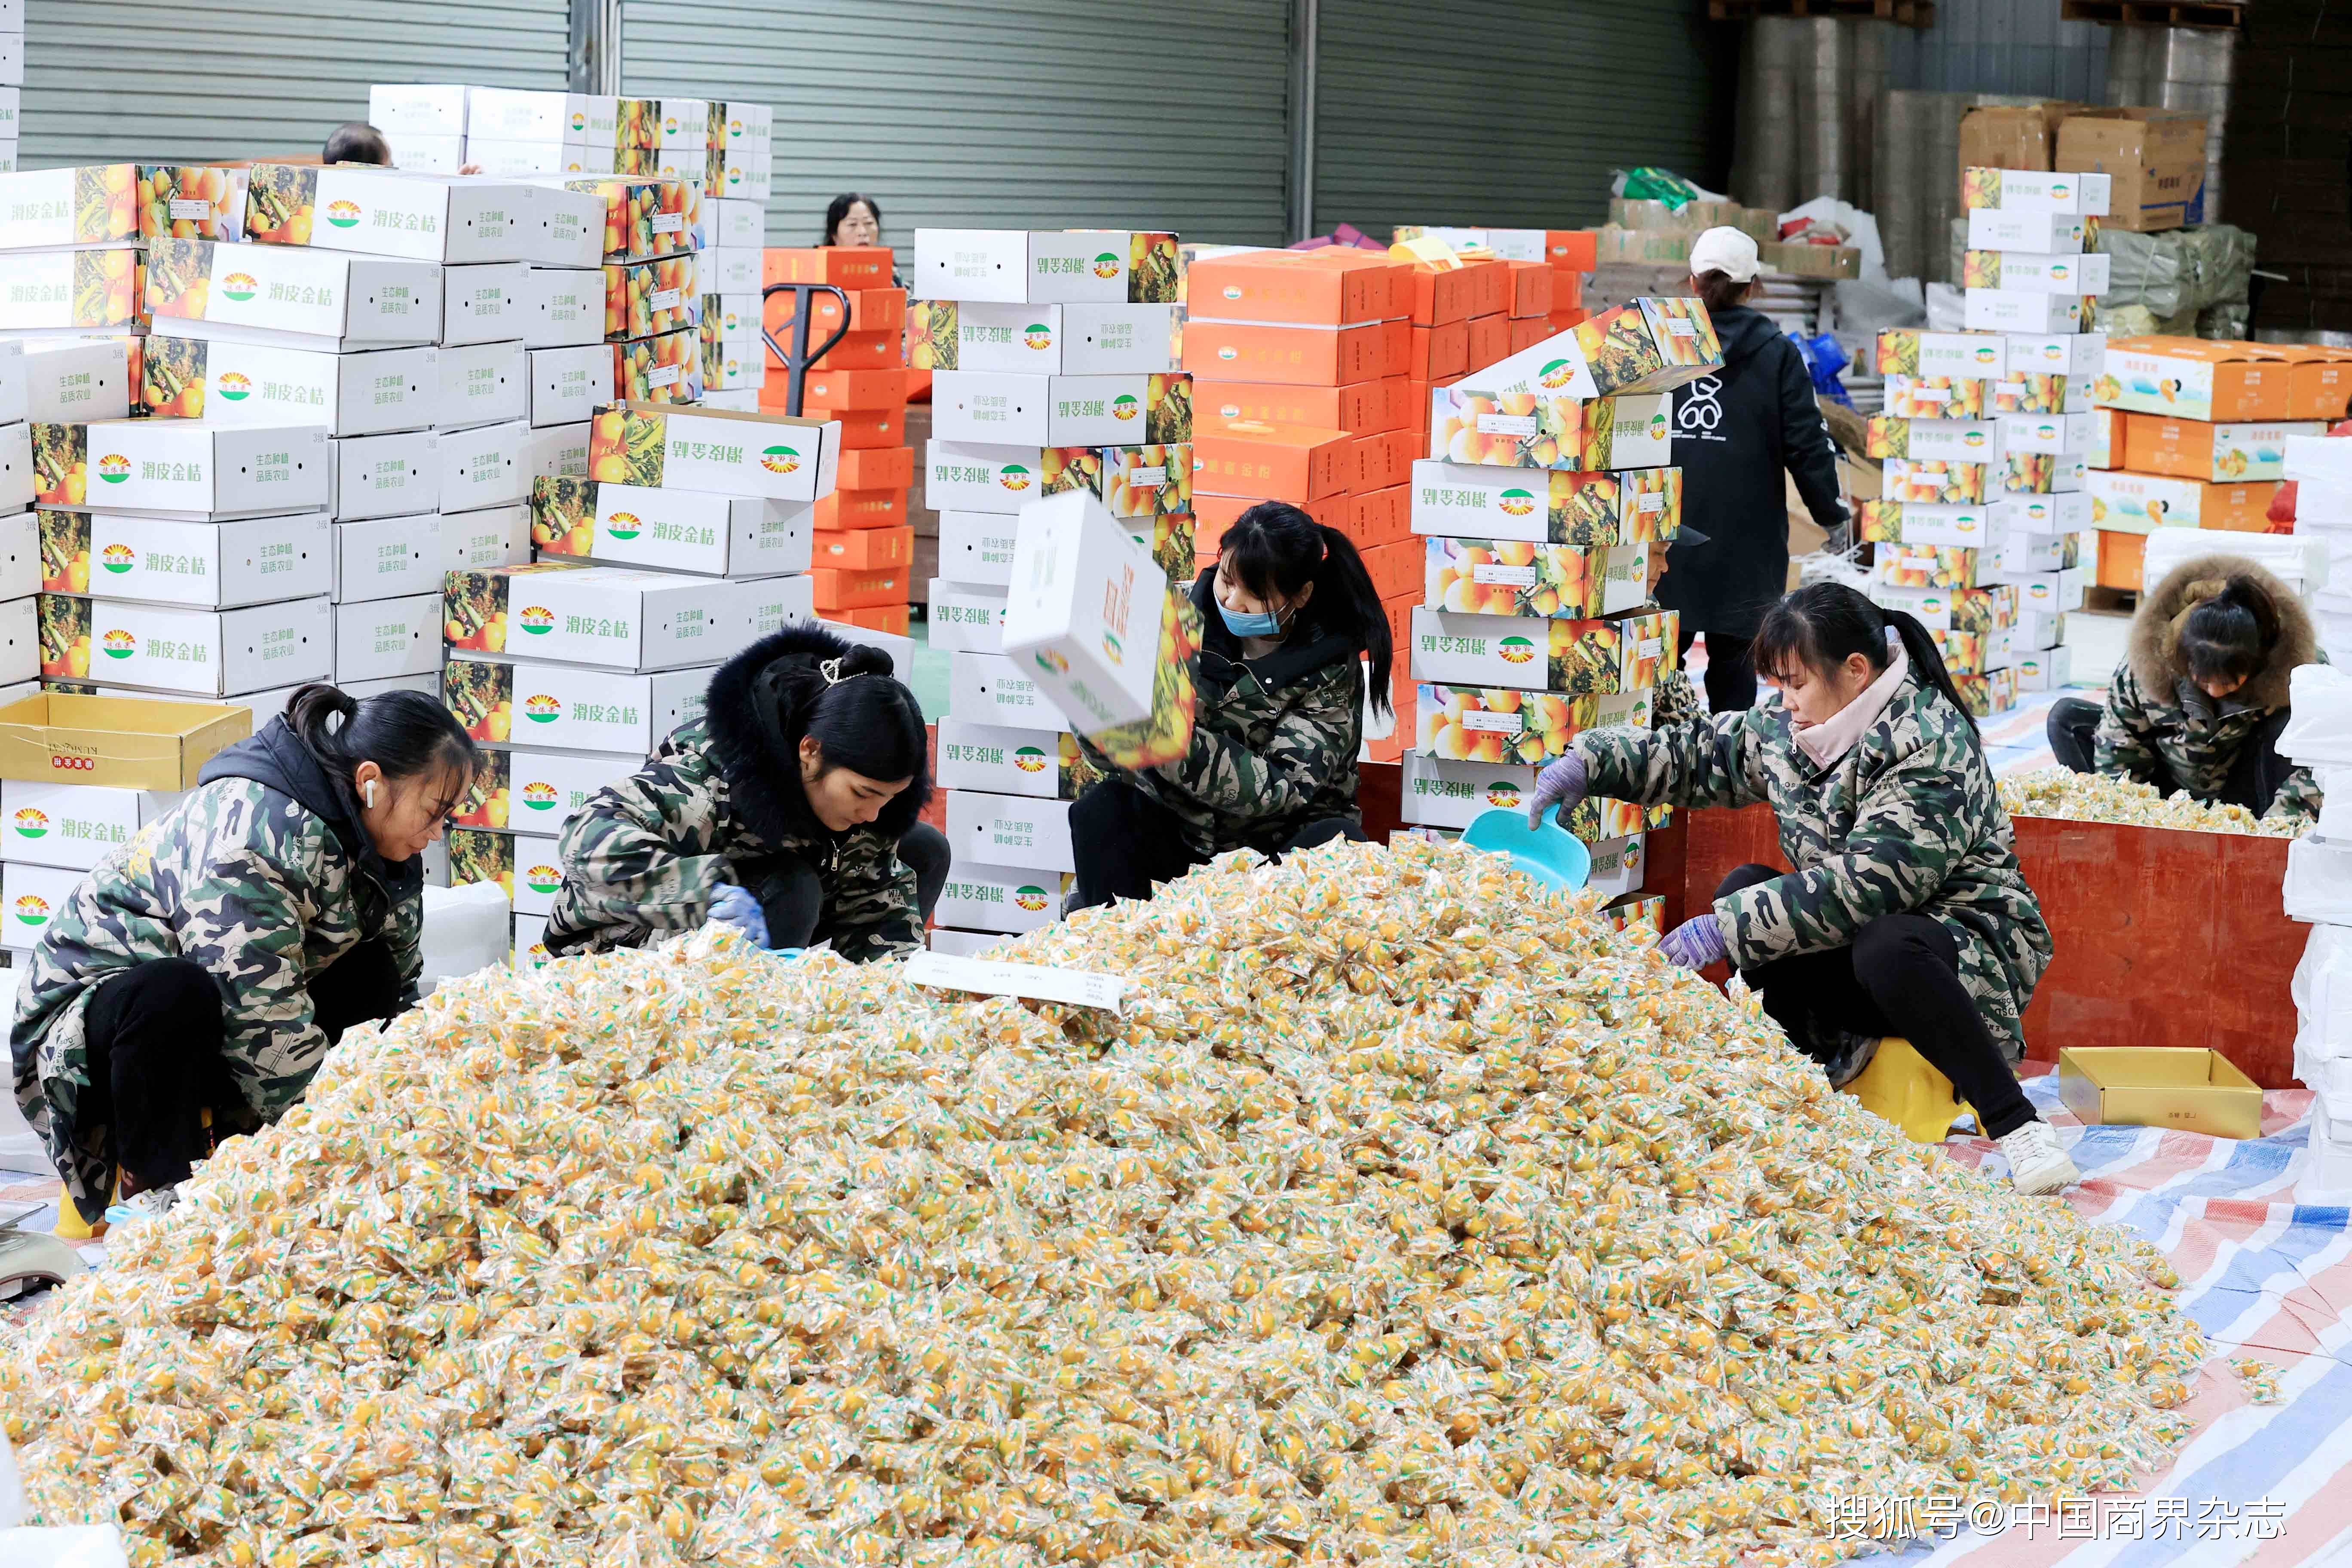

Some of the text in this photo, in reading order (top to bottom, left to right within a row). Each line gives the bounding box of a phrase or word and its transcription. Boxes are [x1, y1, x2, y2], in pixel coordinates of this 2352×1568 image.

[524, 189, 533, 199] 3级
[11, 200, 69, 220] 滑皮金桔
[597, 199, 606, 208] 3级
[372, 208, 437, 233] 滑皮金桔
[479, 210, 504, 223] 生态种植
[554, 213, 578, 226] 生态种植
[478, 227, 503, 238] 品质农业
[553, 227, 577, 241] 品质农业
[954, 251, 987, 264] 品质农业
[954, 266, 987, 278] 生态种植
[1037, 257, 1085, 274] 滑皮金桔
[430, 269, 440, 279] 3级
[520, 269, 529, 278] 3级
[594, 276, 604, 286] 3级
[10, 283, 69, 303] 滑皮金桔
[268, 282, 333, 306] 滑皮金桔
[381, 285, 409, 298] 生态种植
[475, 288, 501, 300] 生态种植
[551, 295, 576, 306] 生态种植
[380, 302, 408, 315] 品质农业
[474, 302, 500, 317] 品质农业
[551, 309, 576, 320] 品质农业
[963, 325, 1012, 344] 滑皮金桔
[1100, 323, 1133, 334] 品质农业
[10, 345, 22, 356] 3级
[513, 343, 523, 354] 3级
[1100, 338, 1132, 349] 生态种植
[113, 348, 124, 359] 3级
[426, 352, 436, 363] 3级
[603, 348, 612, 358] 3级
[59, 372, 91, 387] 生态种植
[374, 374, 404, 389] 生态种植
[467, 368, 494, 381] 生态种植
[561, 370, 586, 383] 生态种植
[262, 381, 324, 406] 滑皮金桔
[468, 382, 494, 396] 品质农业
[561, 385, 586, 398] 品质农业
[59, 388, 91, 406] 品质农业
[374, 391, 403, 405] 品质农业
[973, 395, 1008, 407] 品质农业
[973, 409, 1007, 422] 生态种植
[1059, 400, 1105, 418] 滑皮金桔
[17, 429, 29, 441] 3级
[519, 426, 530, 437] 3级
[1615, 420, 1645, 439] 滑皮金桔
[313, 433, 325, 444] 3级
[426, 438, 437, 449] 3级
[256, 452, 289, 466] 生态种植
[560, 447, 586, 460] 生态种植
[672, 440, 743, 464] 滑皮金桔
[374, 459, 405, 474] 生态种植
[472, 452, 500, 468] 生态种植
[141, 461, 202, 482] 滑皮金桔
[472, 467, 501, 483] 品质农业
[560, 462, 585, 474] 品质农业
[935, 465, 989, 484] 滑皮金桔
[256, 469, 289, 483] 品质农业
[375, 475, 404, 490] 品质农业
[1422, 488, 1487, 508] 滑皮金桔
[519, 509, 530, 520] 3级
[25, 521, 37, 532] 3级
[316, 519, 327, 530] 3级
[429, 522, 440, 533] 3级
[760, 521, 784, 534] 生态种植
[471, 533, 499, 548] 生态种植
[652, 521, 715, 546] 滑皮金桔
[759, 536, 784, 549] 品质农业
[260, 543, 293, 557] 生态种植
[378, 543, 407, 557] 生态种植
[471, 550, 498, 564] 品质农业
[145, 552, 205, 576] 滑皮金桔
[260, 559, 293, 575] 品质农业
[378, 559, 407, 573] 品质农业
[22, 604, 34, 616] 3级
[316, 603, 328, 614] 3级
[429, 603, 440, 614] 3级
[757, 603, 784, 617] 生态种植
[937, 605, 989, 625] 滑皮金桔
[676, 609, 704, 623] 生态种植
[565, 615, 629, 639] 滑皮金桔
[675, 625, 703, 640] 品质农业
[262, 628, 294, 644] 生态种植
[146, 638, 207, 663] 滑皮金桔
[1421, 634, 1486, 655] 滑皮金桔
[262, 643, 295, 661] 品质农业
[426, 680, 437, 690] 3级
[997, 678, 1034, 691] 品质农业
[996, 693, 1034, 706] 生态种植
[572, 702, 638, 725] 滑皮金桔
[49, 743, 98, 755] KUMQUAT
[946, 744, 1004, 765] 滑皮金桔
[1413, 775, 1475, 800] 滑皮金桔
[61, 818, 126, 844] 滑皮金桔
[994, 819, 1033, 833] 品质农业
[993, 833, 1032, 848] 生态种植
[1592, 851, 1619, 876] 滑皮金桔
[945, 882, 1004, 903] 滑皮金桔
